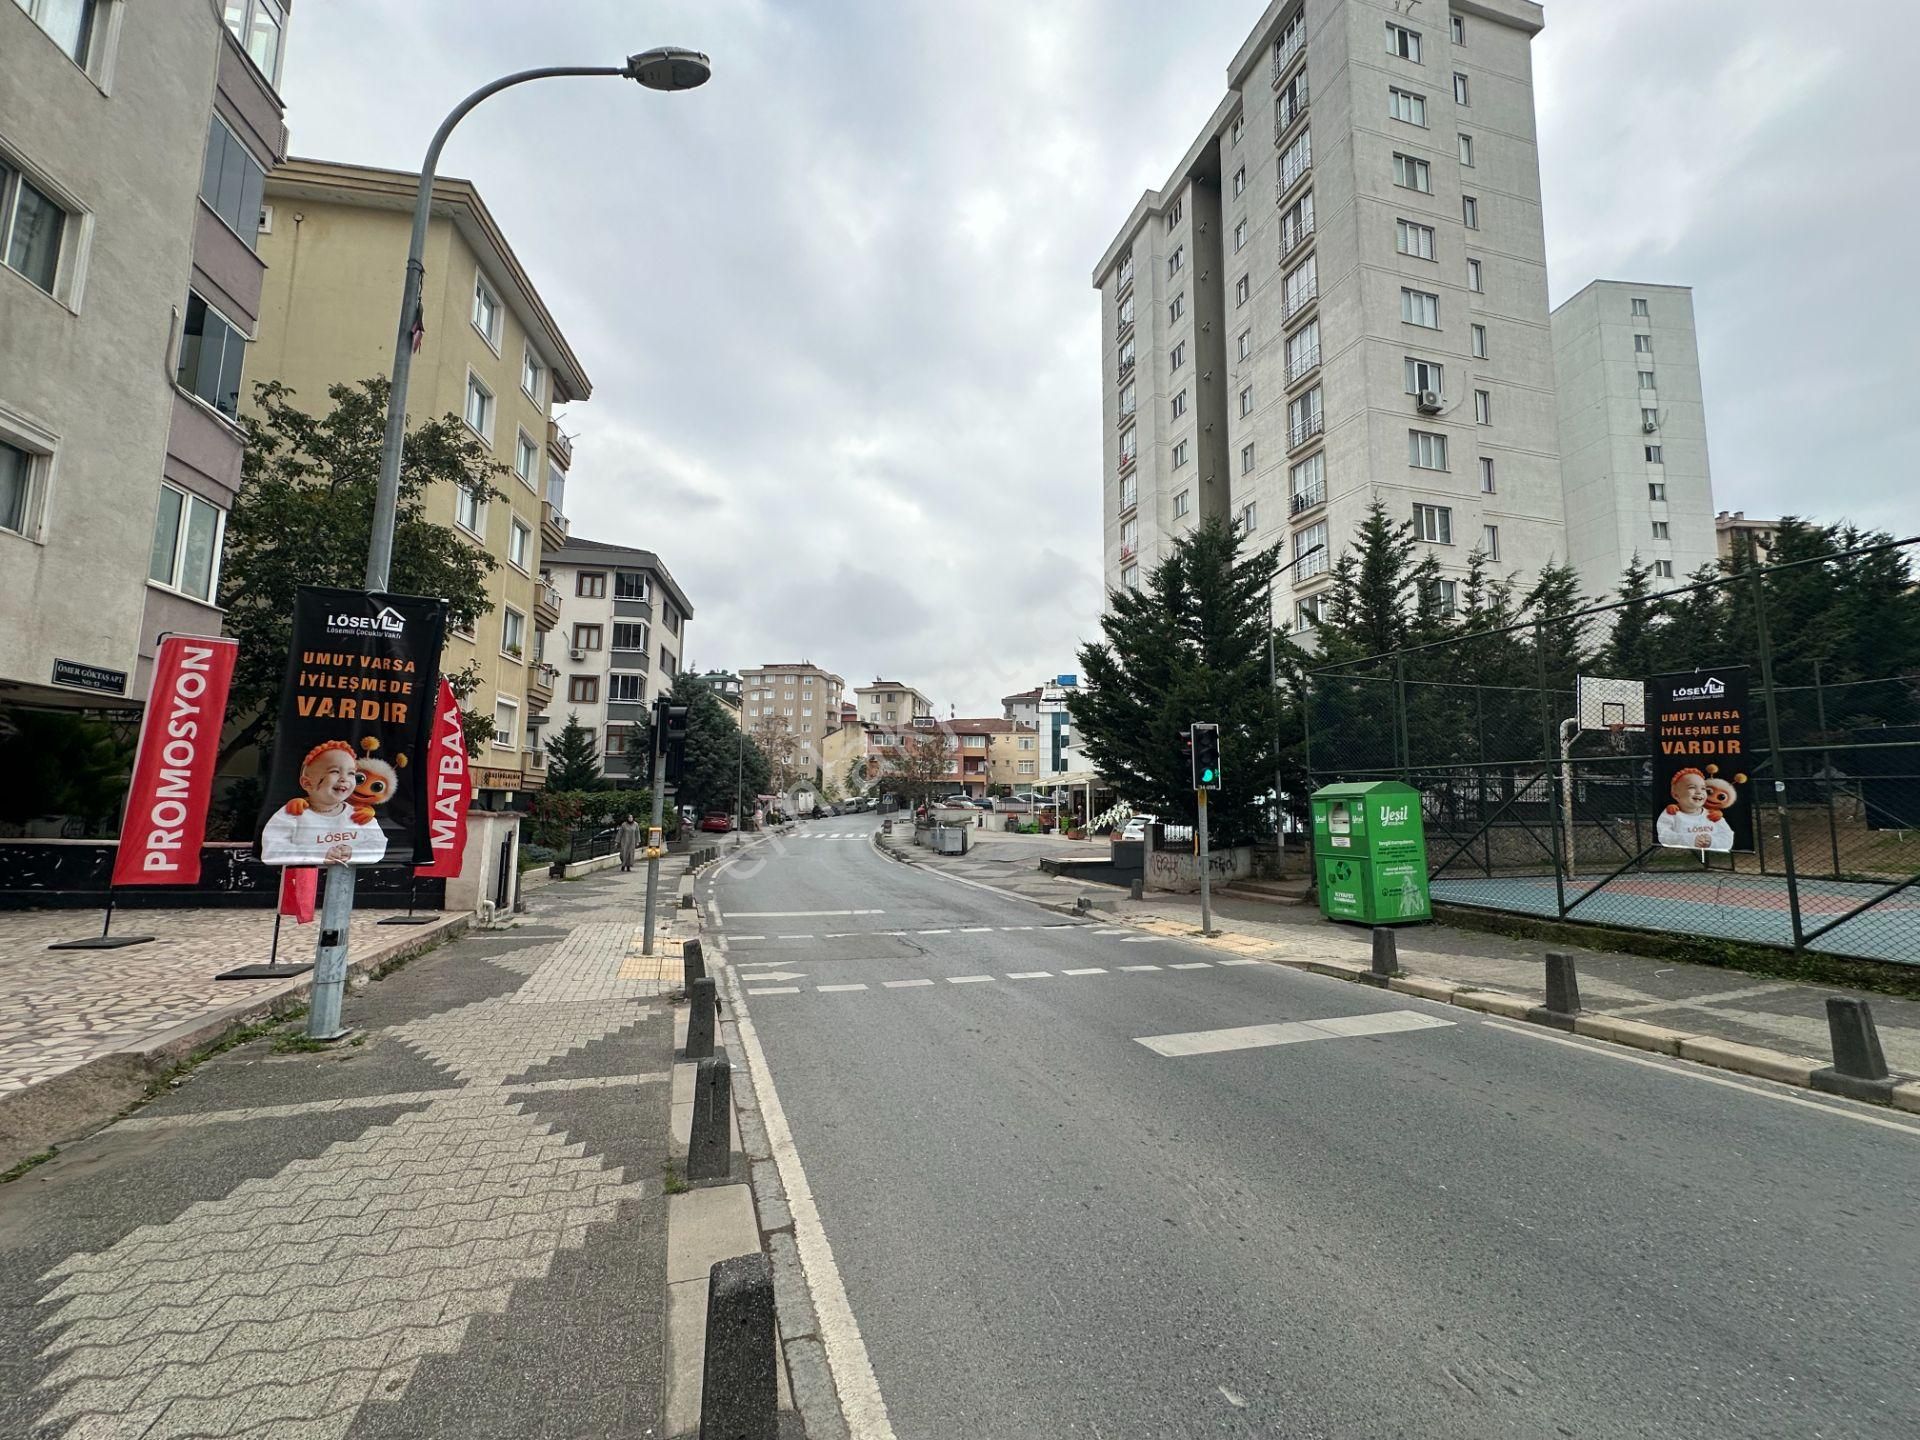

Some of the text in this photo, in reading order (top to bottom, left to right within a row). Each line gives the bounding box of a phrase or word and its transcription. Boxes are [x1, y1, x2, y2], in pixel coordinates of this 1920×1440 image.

[327, 614, 381, 630] LÖSEV
[303, 651, 415, 673] UMUT VARSA
[1672, 687, 1709, 697] LÖSEV
[297, 695, 408, 724] VARDIR
[1661, 710, 1740, 722] UMUT VARSA
[1661, 725, 1740, 737] İYİLEŞME DE
[1661, 740, 1741, 755] VARDIR
[143, 646, 213, 871] PROMOSYON
[431, 706, 464, 850] MATBAA
[316, 831, 358, 844] LÖSEV
